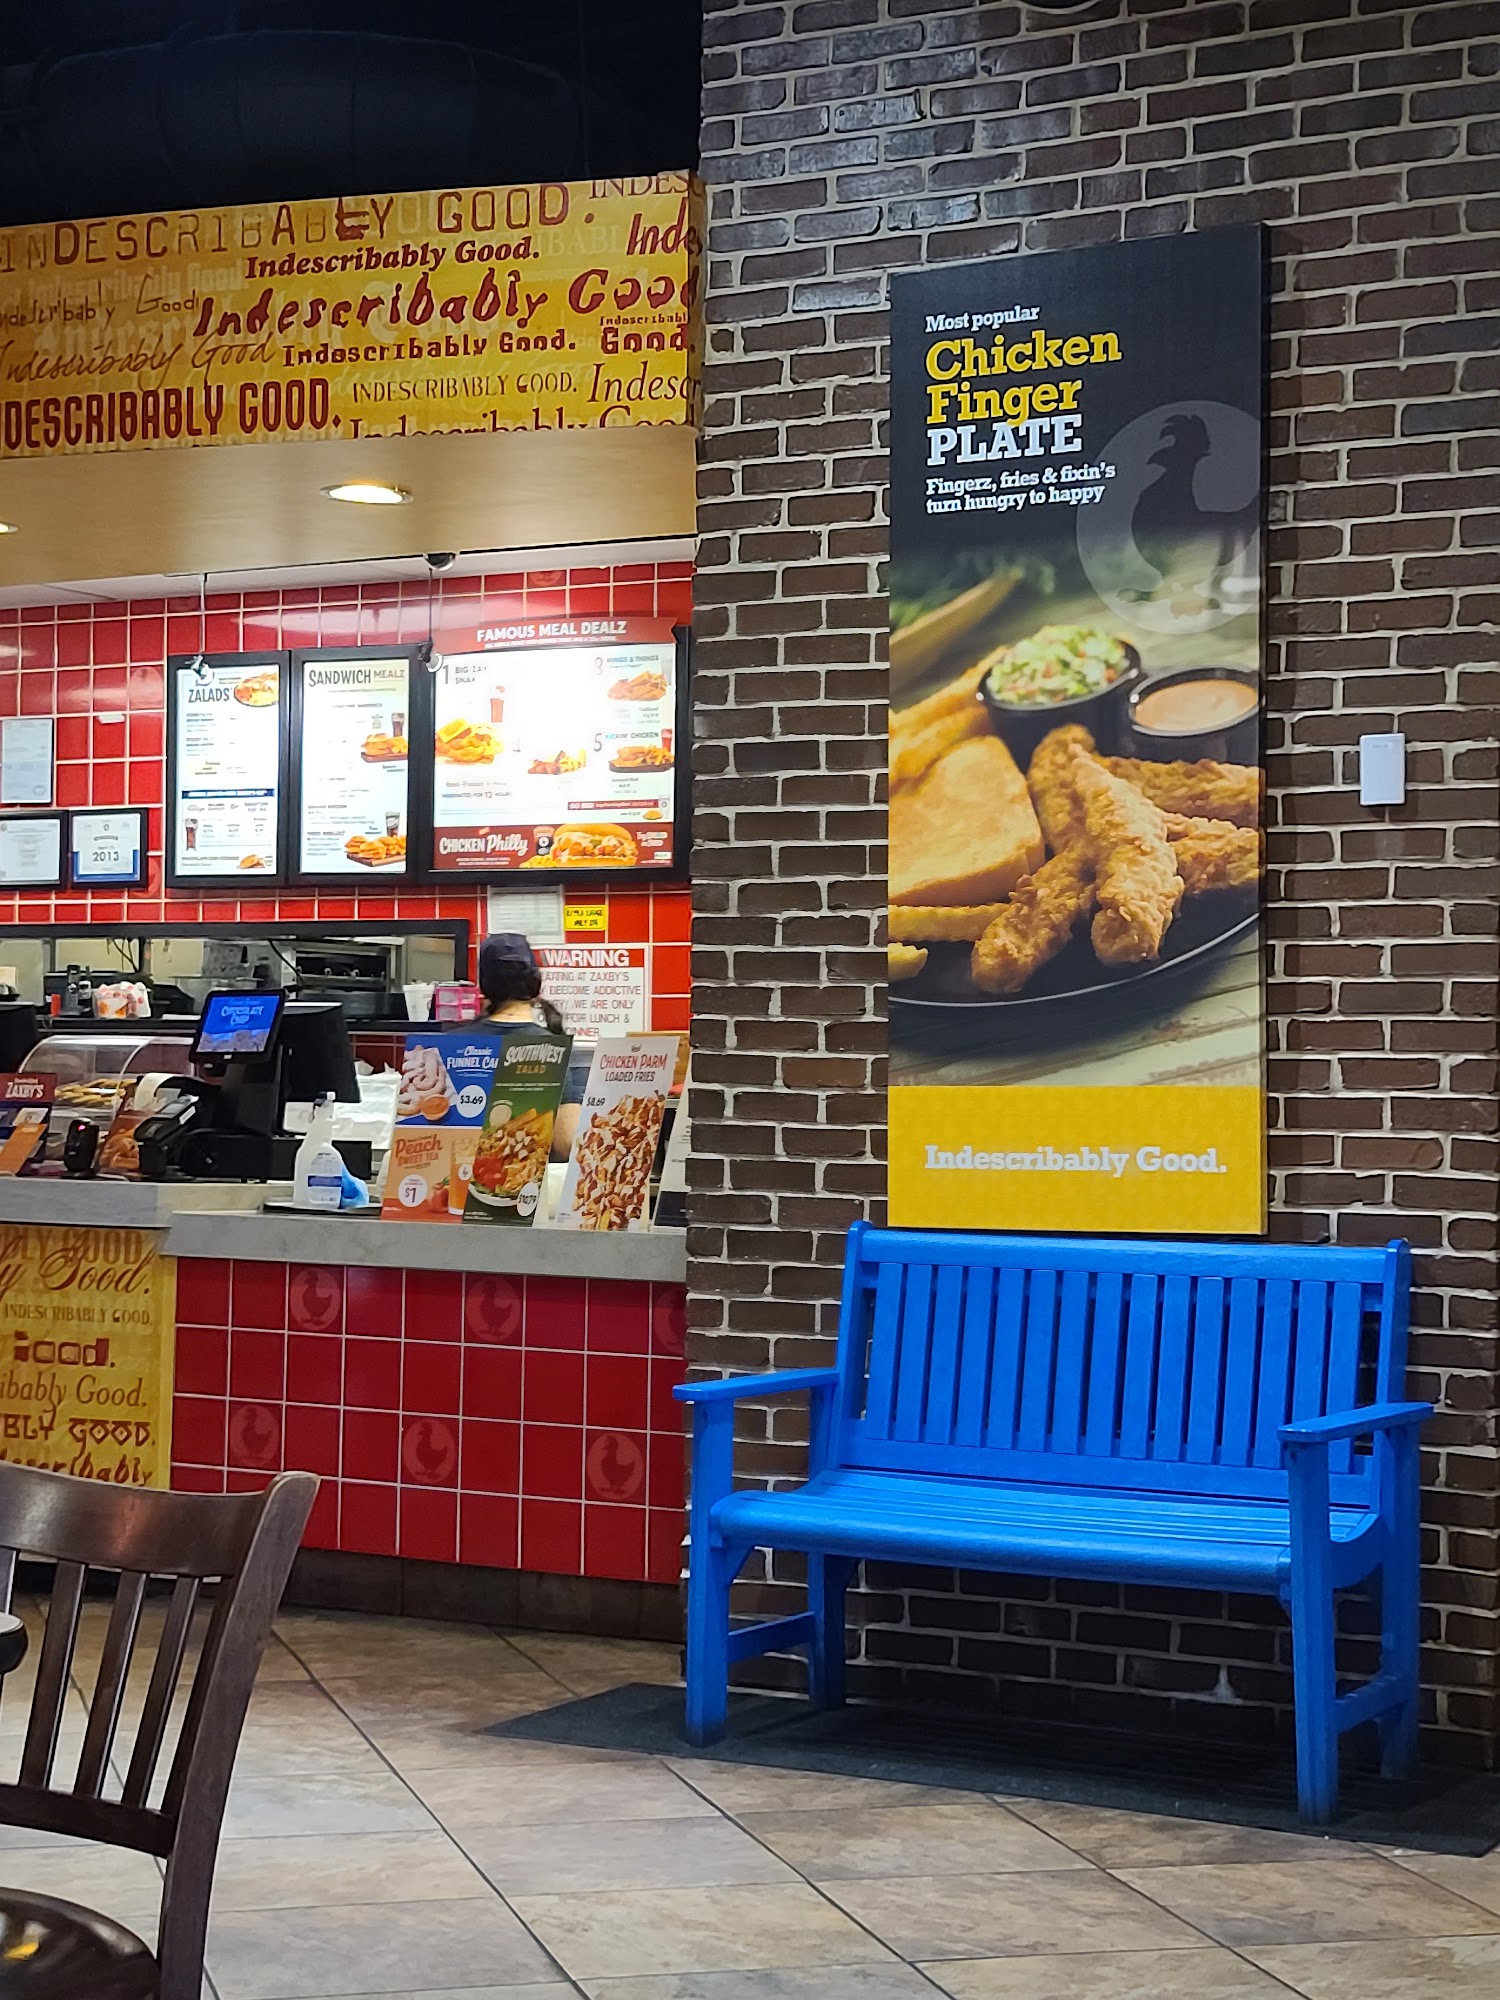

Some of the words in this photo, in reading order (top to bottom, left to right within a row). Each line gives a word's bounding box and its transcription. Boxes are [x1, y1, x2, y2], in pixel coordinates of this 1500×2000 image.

[437, 183, 595, 234] GOOD.
[245, 241, 447, 280] Indescribably
[454, 236, 540, 264] Good.
[192, 267, 548, 337] Indescribably
[925, 313, 969, 333] Most
[971, 305, 1040, 332] popular
[282, 334, 487, 368] Indescribably
[499, 328, 577, 353] Good.
[925, 329, 1122, 382] Chicken
[352, 374, 509, 404] INDESCRIBABLY
[516, 371, 578, 394] GOOD.
[0, 384, 224, 450] DESCRIBABLY
[239, 378, 342, 435] GOOD.
[926, 379, 1082, 427] Finger
[926, 413, 1083, 466] PLATE
[925, 477, 998, 496] Fingerz,
[1000, 471, 1040, 489] fries
[1043, 467, 1058, 484] &
[1059, 461, 1116, 483] fixin's
[926, 496, 962, 515] turn
[964, 490, 1028, 514] hungry
[1030, 488, 1046, 505] to
[1048, 483, 1106, 508] happy
[476, 624, 536, 643] FAMOUS
[539, 622, 578, 638] MEAL
[581, 620, 627, 636] DEALZ
[309, 668, 372, 688] SANDWICH
[373, 669, 405, 679] MEALZ
[188, 687, 231, 704] ZALADS
[593, 732, 603, 753] 5
[92, 851, 120, 862] 2013
[439, 837, 486, 855] CHICKEN
[486, 833, 529, 857] Philly
[545, 949, 630, 967] WARNING
[577, 971, 587, 982] AT
[589, 971, 630, 982] ZAXBY'S
[593, 985, 642, 996] ADDICTIVE
[591, 1000, 608, 1009] ARE
[611, 999, 635, 1010] ONLY
[590, 1013, 620, 1024] LUNCH
[623, 1013, 630, 1024] &
[464, 1045, 494, 1057] Classic
[503, 1043, 567, 1067] SOUTHWEST
[600, 1053, 637, 1070] CHICKEN
[640, 1052, 668, 1070] PARM
[446, 1057, 481, 1070] FUNNEL
[516, 1064, 547, 1075] ZALAD
[604, 1072, 634, 1083] LOADED
[634, 1070, 656, 1083] FRIES
[460, 1094, 484, 1105] $3.69
[586, 1097, 606, 1107] $8.69
[395, 1133, 443, 1159] Peach
[425, 1151, 439, 1163] TEA
[924, 1144, 1131, 1178] Indescribably
[1136, 1145, 1228, 1174] Good.
[76, 1373, 149, 1407] Good.
